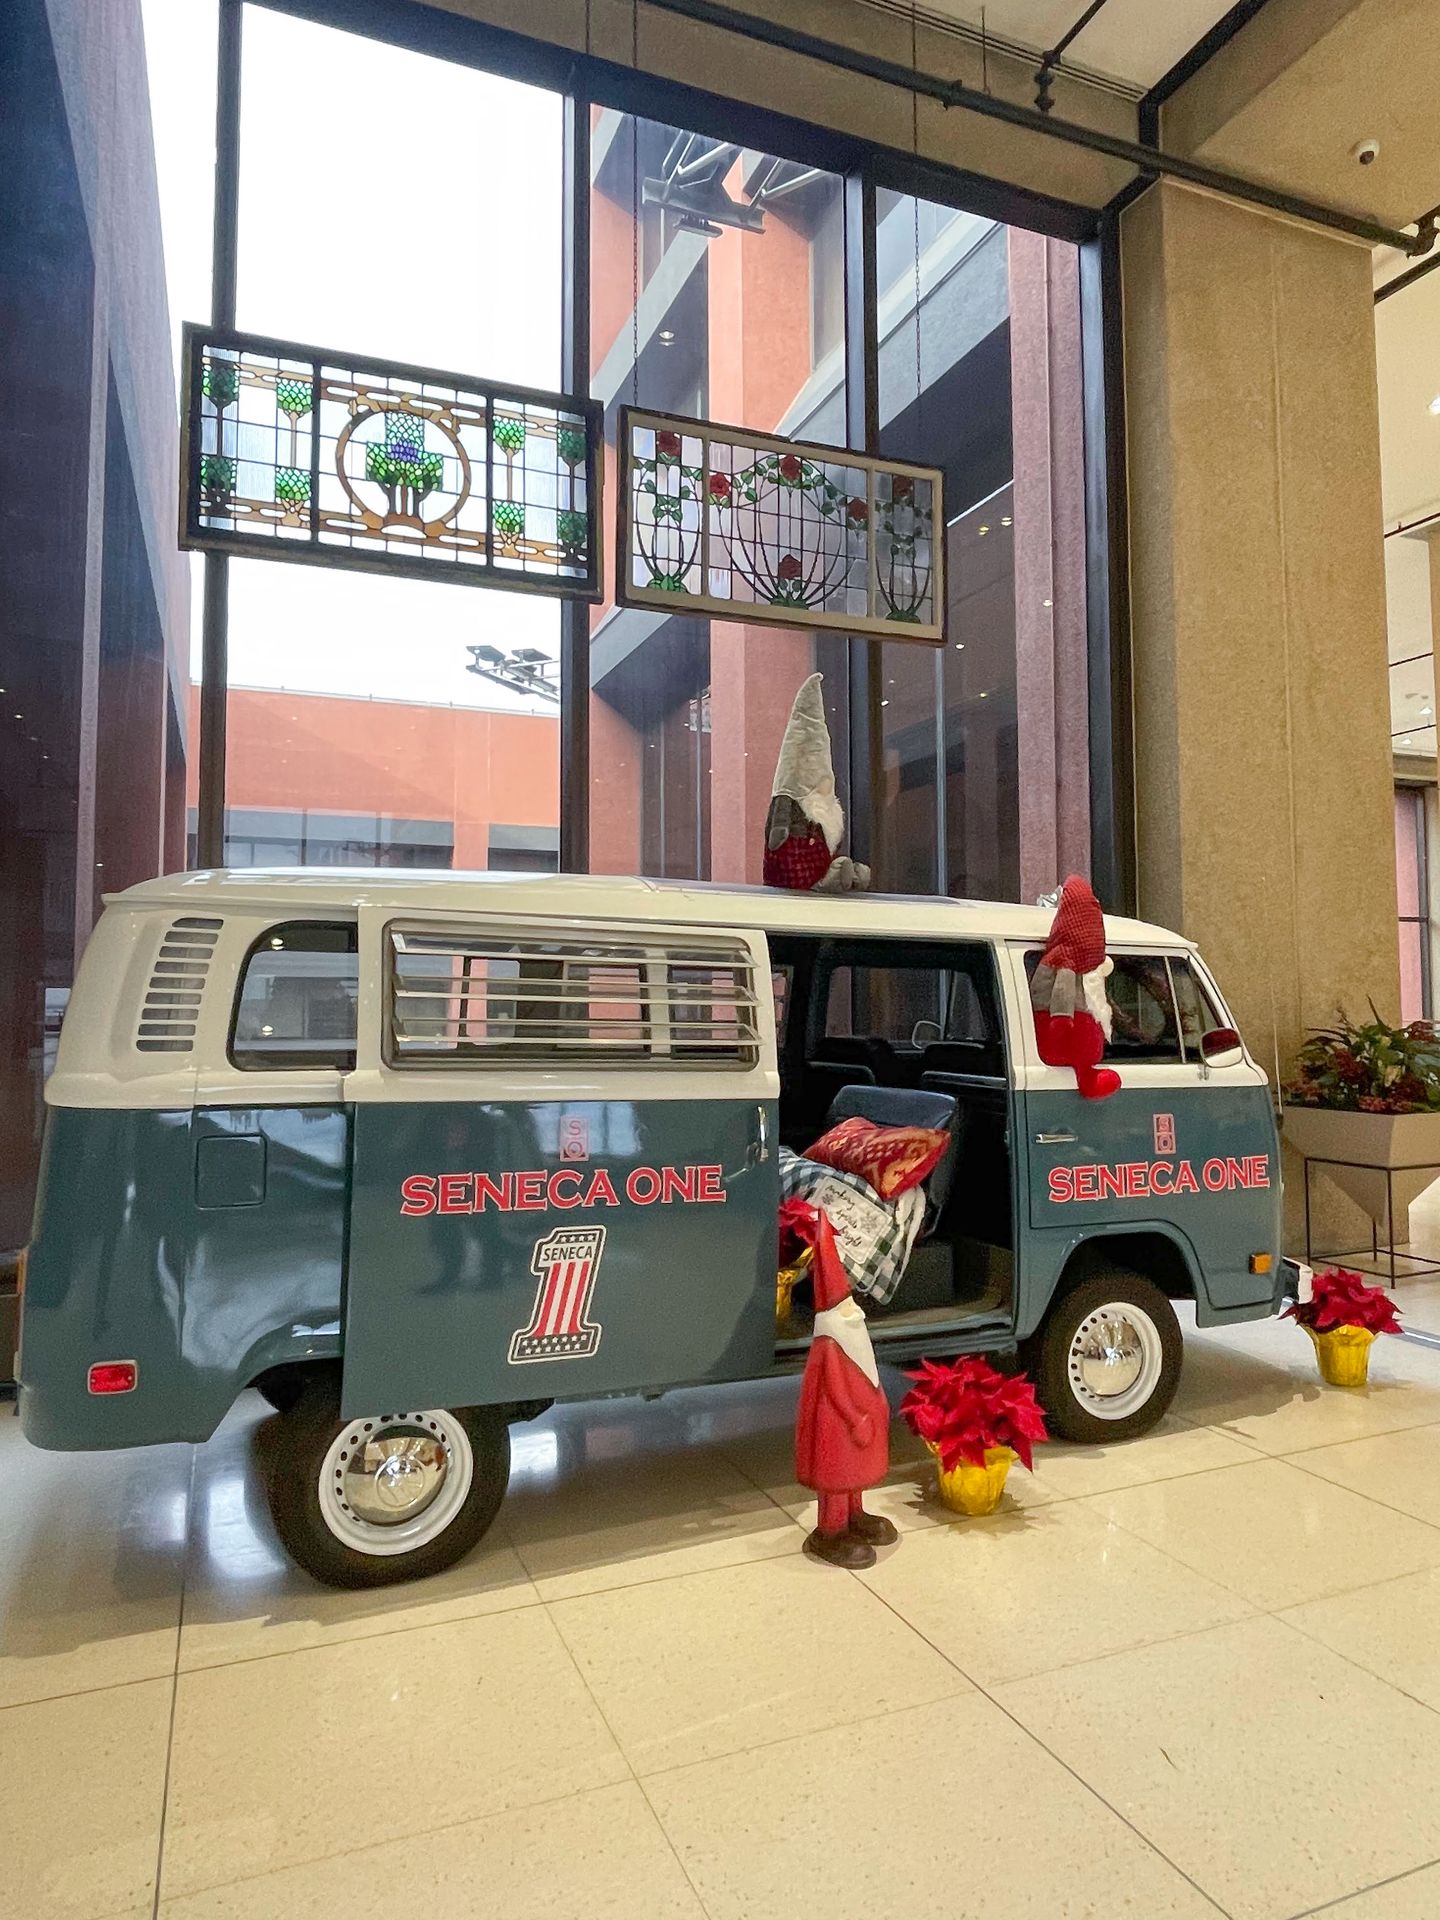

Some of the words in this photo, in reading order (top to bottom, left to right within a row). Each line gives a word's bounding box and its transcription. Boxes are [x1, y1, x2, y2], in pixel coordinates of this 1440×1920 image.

[401, 1169, 620, 1216] SENECA
[625, 1164, 727, 1205] ONE
[1049, 1160, 1200, 1203] SENECA
[1202, 1154, 1271, 1192] ONE
[543, 1246, 593, 1261] SENECA
